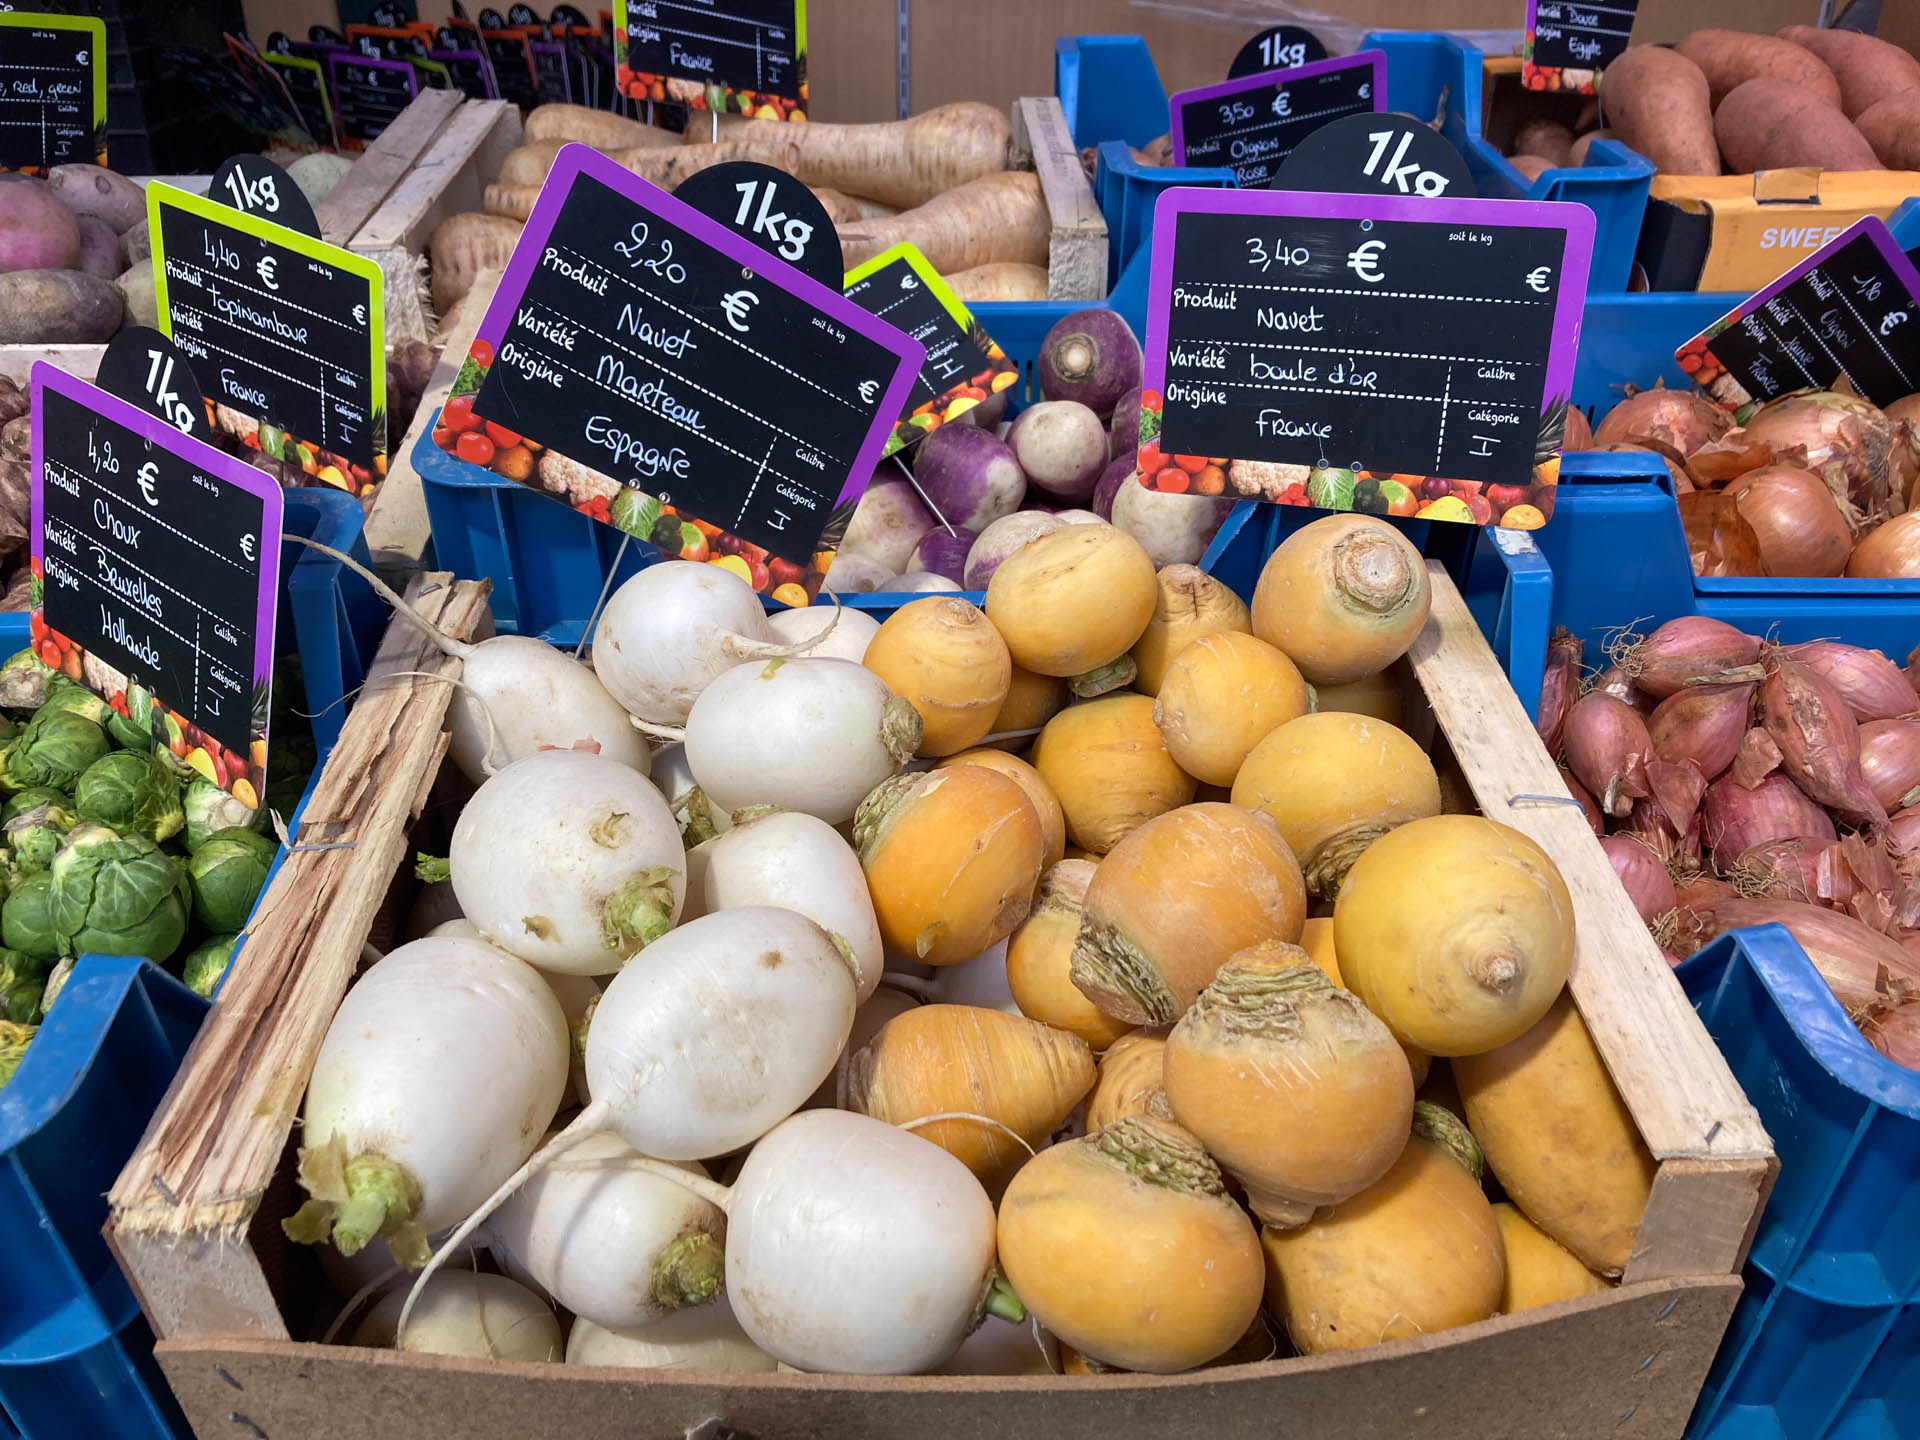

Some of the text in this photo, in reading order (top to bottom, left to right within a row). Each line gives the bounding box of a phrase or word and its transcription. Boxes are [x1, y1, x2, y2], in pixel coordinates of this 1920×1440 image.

[628, 24, 661, 44] Origine
[76, 50, 89, 66] €
[1258, 32, 1307, 69] 1kg
[1358, 83, 1370, 99] €
[1218, 91, 1293, 125] 3,50 €
[1236, 165, 1268, 181] Rose
[1362, 129, 1450, 198] 1kg
[225, 164, 280, 213] 1kg
[735, 180, 814, 261] 1kg
[1449, 231, 1493, 246] soit le kg
[1760, 227, 1850, 248] SWEE
[204, 229, 279, 290] 4,40 €
[1246, 237, 1387, 283] 3,40 €
[166, 260, 203, 288] Produit
[613, 221, 760, 333] 2,20 €
[900, 274, 919, 290] €
[1525, 266, 1552, 293] €
[1804, 269, 1834, 301] Produit
[352, 304, 367, 326] €
[542, 247, 697, 359] Produit Navet
[1173, 288, 1325, 332] Produit Navet
[1764, 298, 1795, 326] Variété
[170, 307, 204, 332] Variété
[811, 316, 847, 344] soit le kg
[1742, 314, 1767, 343] Origine
[1880, 311, 1908, 336] €
[174, 333, 208, 359] Origine
[516, 307, 706, 429] Variété Marteau
[1169, 345, 1227, 369] Variété
[1250, 353, 1318, 382] boule
[1477, 366, 1516, 381] Calibre
[145, 349, 196, 435] 1kg
[335, 372, 357, 389] Calibre
[857, 380, 880, 404] €
[1166, 383, 1227, 409] Origine
[334, 403, 363, 423] Catégorie
[500, 343, 691, 478] Origine Espagne
[1467, 409, 1520, 426] Catégorie
[795, 448, 825, 471] Calibre
[1469, 434, 1502, 457] I
[88, 430, 160, 507] 4,20 €
[191, 473, 220, 497] soit le kg
[775, 483, 817, 511] Catégorie
[44, 462, 141, 549] Produit Choux
[767, 509, 791, 531] I
[239, 533, 256, 562] €
[44, 520, 163, 617] Variété Bruxelles
[44, 556, 162, 671] Origine Hollande
[213, 624, 238, 647] Calibre
[210, 665, 243, 694] Catégorie
